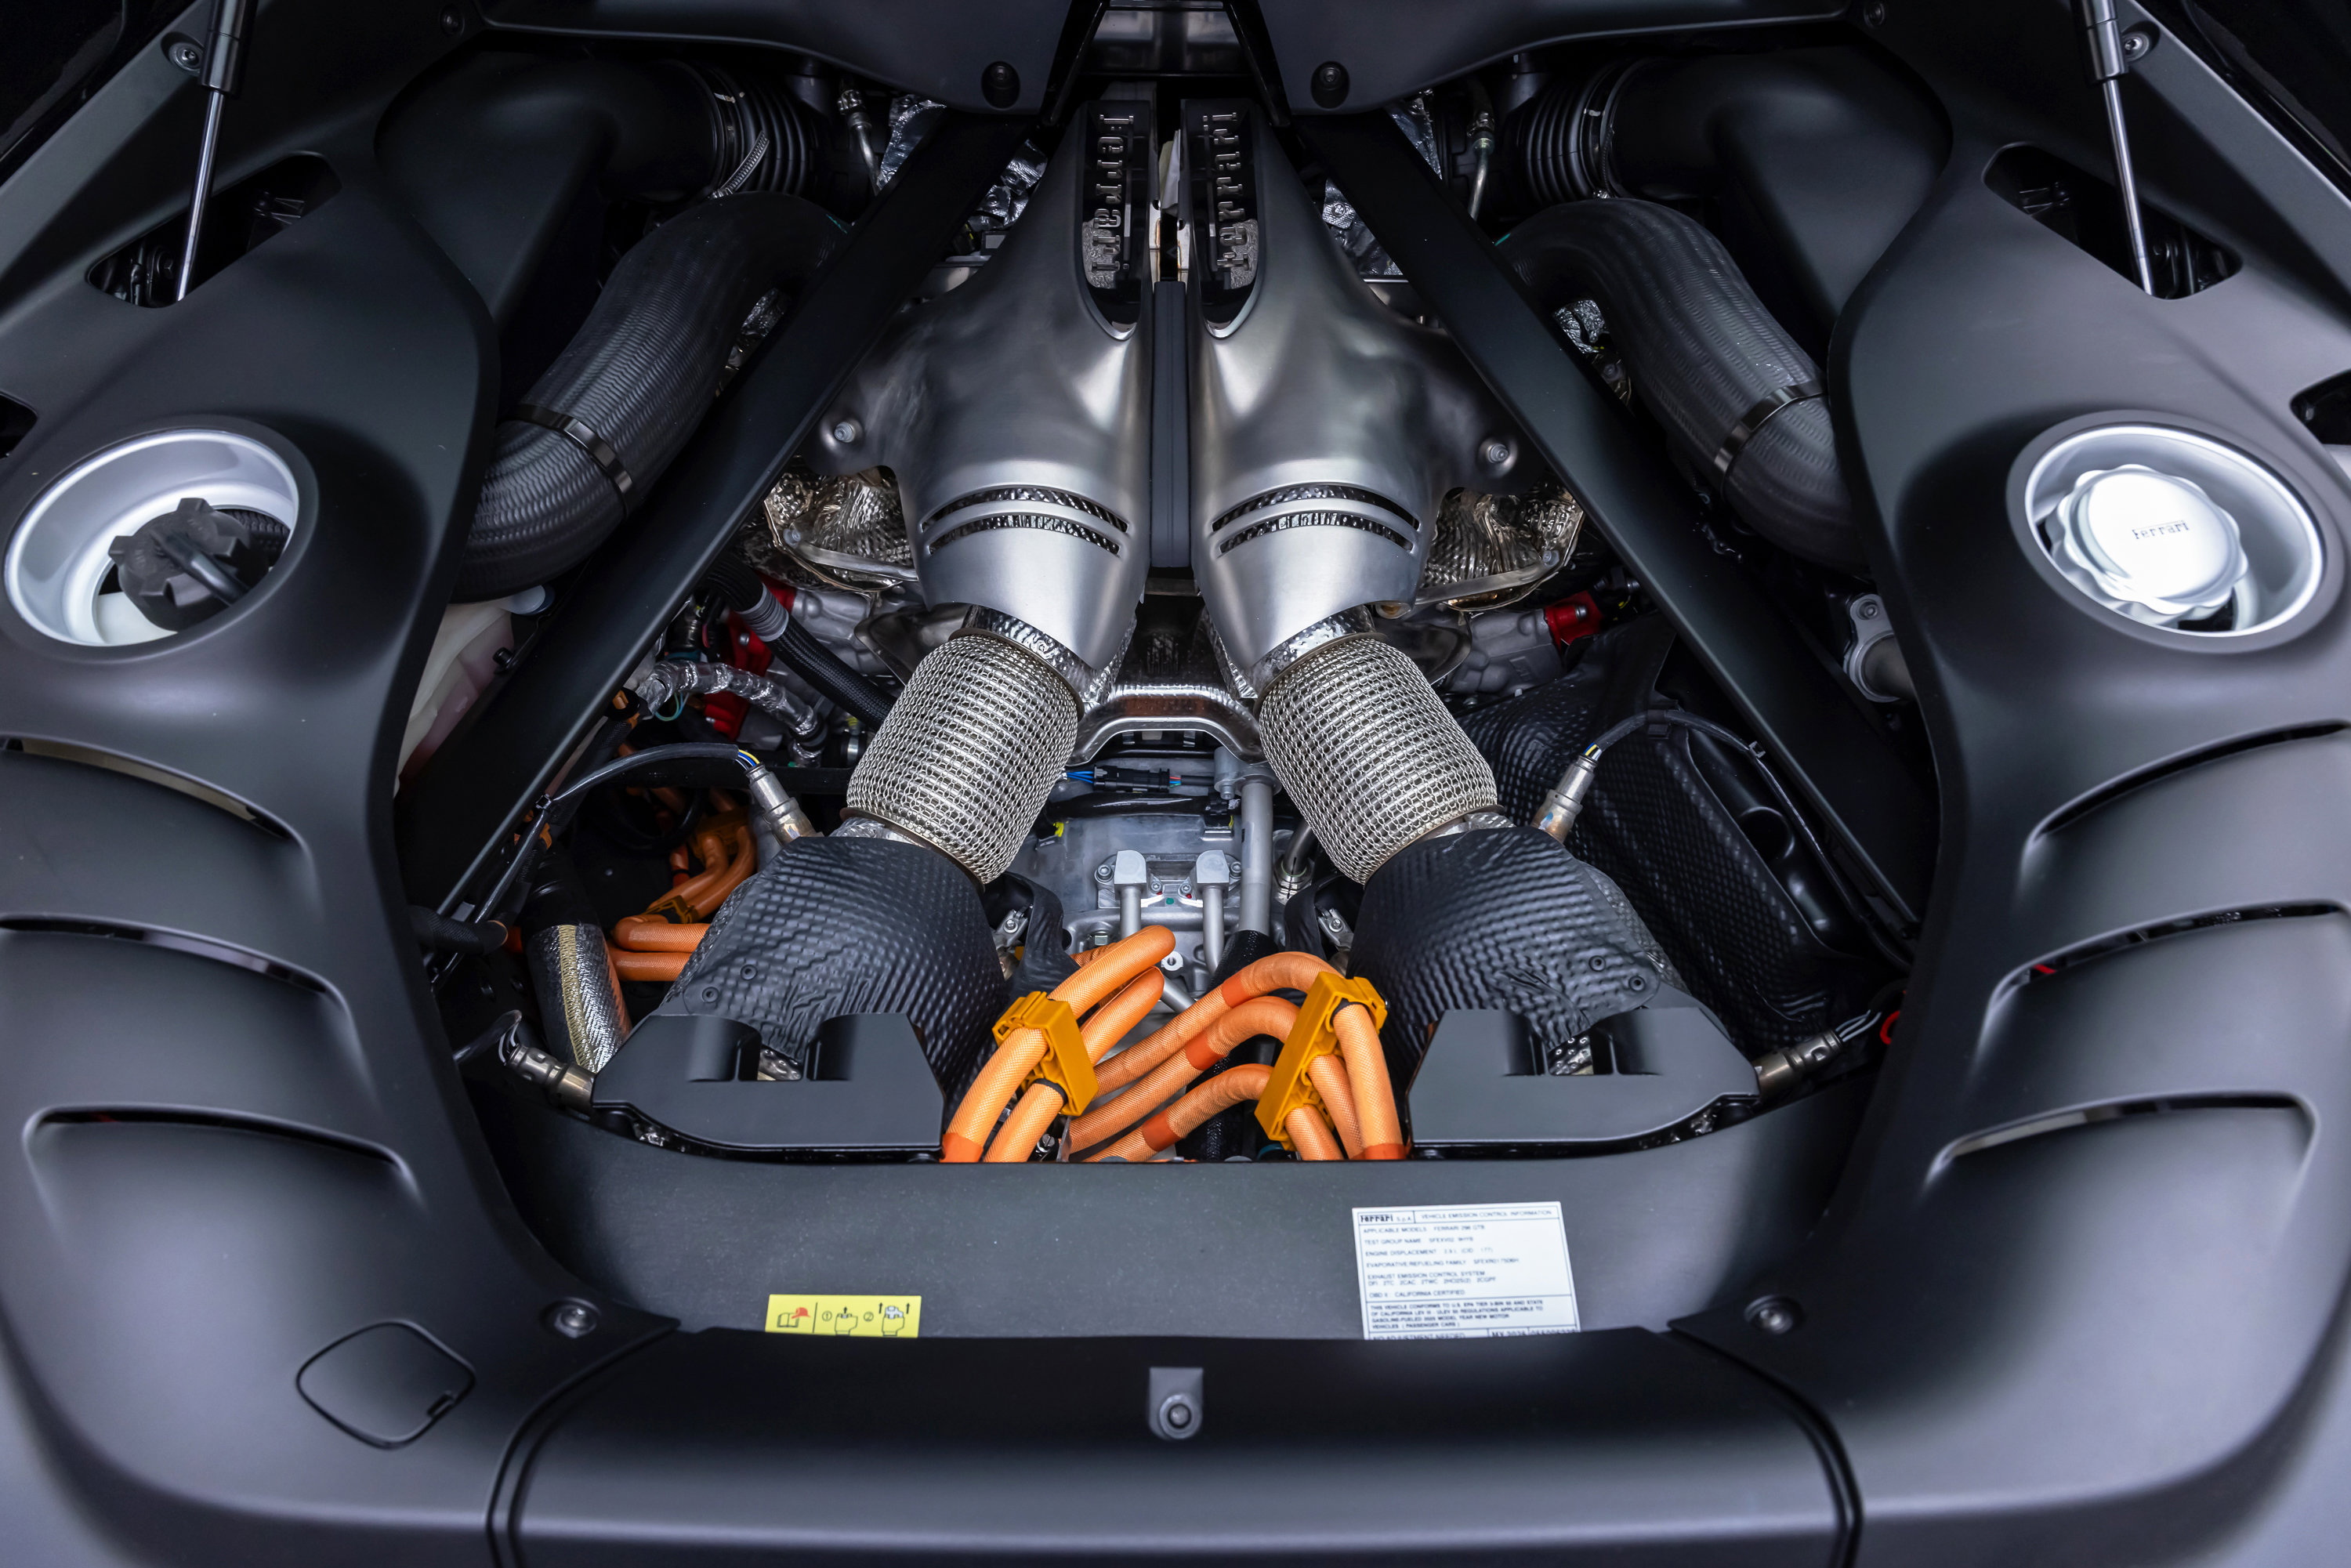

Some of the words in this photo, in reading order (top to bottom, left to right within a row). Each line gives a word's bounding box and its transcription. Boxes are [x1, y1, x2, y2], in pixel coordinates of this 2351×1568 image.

[1202, 111, 1250, 273] Ferrari
[2132, 520, 2190, 540] Ferrari
[1360, 1214, 1393, 1222] Ferrari
